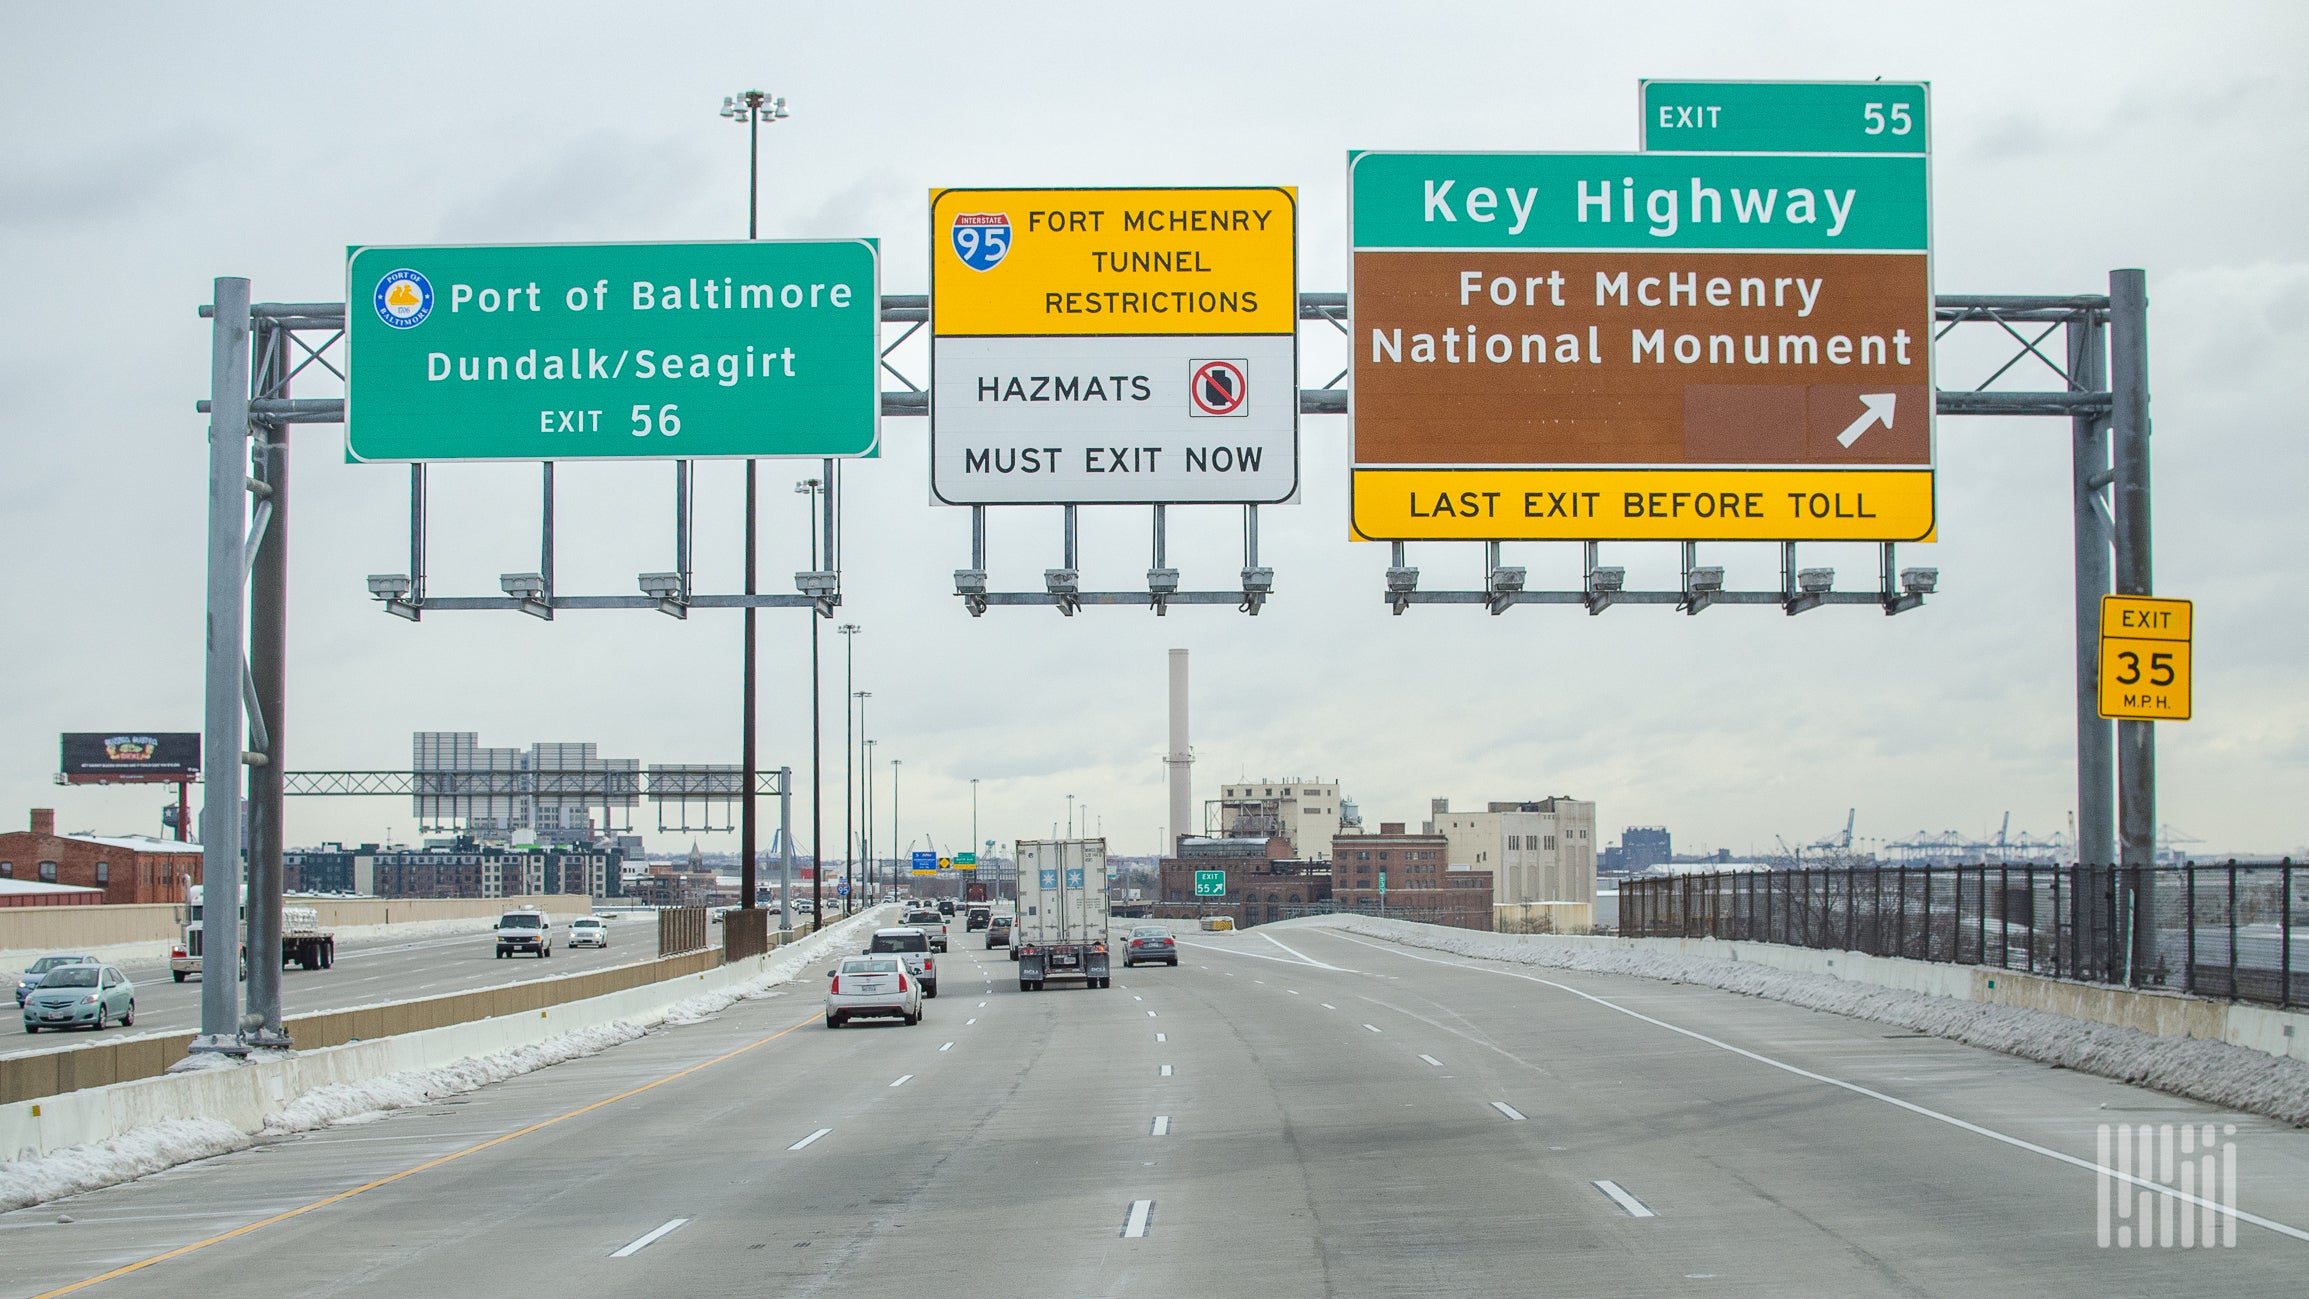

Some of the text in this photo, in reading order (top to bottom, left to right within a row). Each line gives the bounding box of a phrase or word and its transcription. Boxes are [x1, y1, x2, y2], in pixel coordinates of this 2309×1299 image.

[1660, 103, 1911, 135] EXIT 55
[1425, 177, 1856, 236] Key Highway
[961, 216, 1002, 225] INTERSTATE
[1030, 210, 1271, 232] FORT MCHENRY
[957, 228, 1007, 262] 95
[1092, 252, 1211, 272] TUNNEL
[386, 272, 422, 283] PORT OF
[452, 277, 851, 314] Port of Baltimore
[1046, 292, 1257, 313] RESTRICTIONS
[1461, 271, 1823, 316] Fort McHenry
[380, 307, 429, 326] BALTIMORE
[1373, 325, 1911, 364] National Monument
[428, 346, 795, 386] Dundalk/Seagirt
[979, 376, 1150, 401] HAZMATS
[541, 404, 680, 436] EXIT 56
[966, 447, 1262, 473] MUST EXIT NOW
[1411, 492, 1876, 518] LAST EXIT BEFORE TOLL
[2123, 610, 2171, 628] EXIT
[2116, 651, 2175, 687] 35
[2123, 694, 2171, 709] M.P.H.
[1197, 884, 1210, 893] 55
